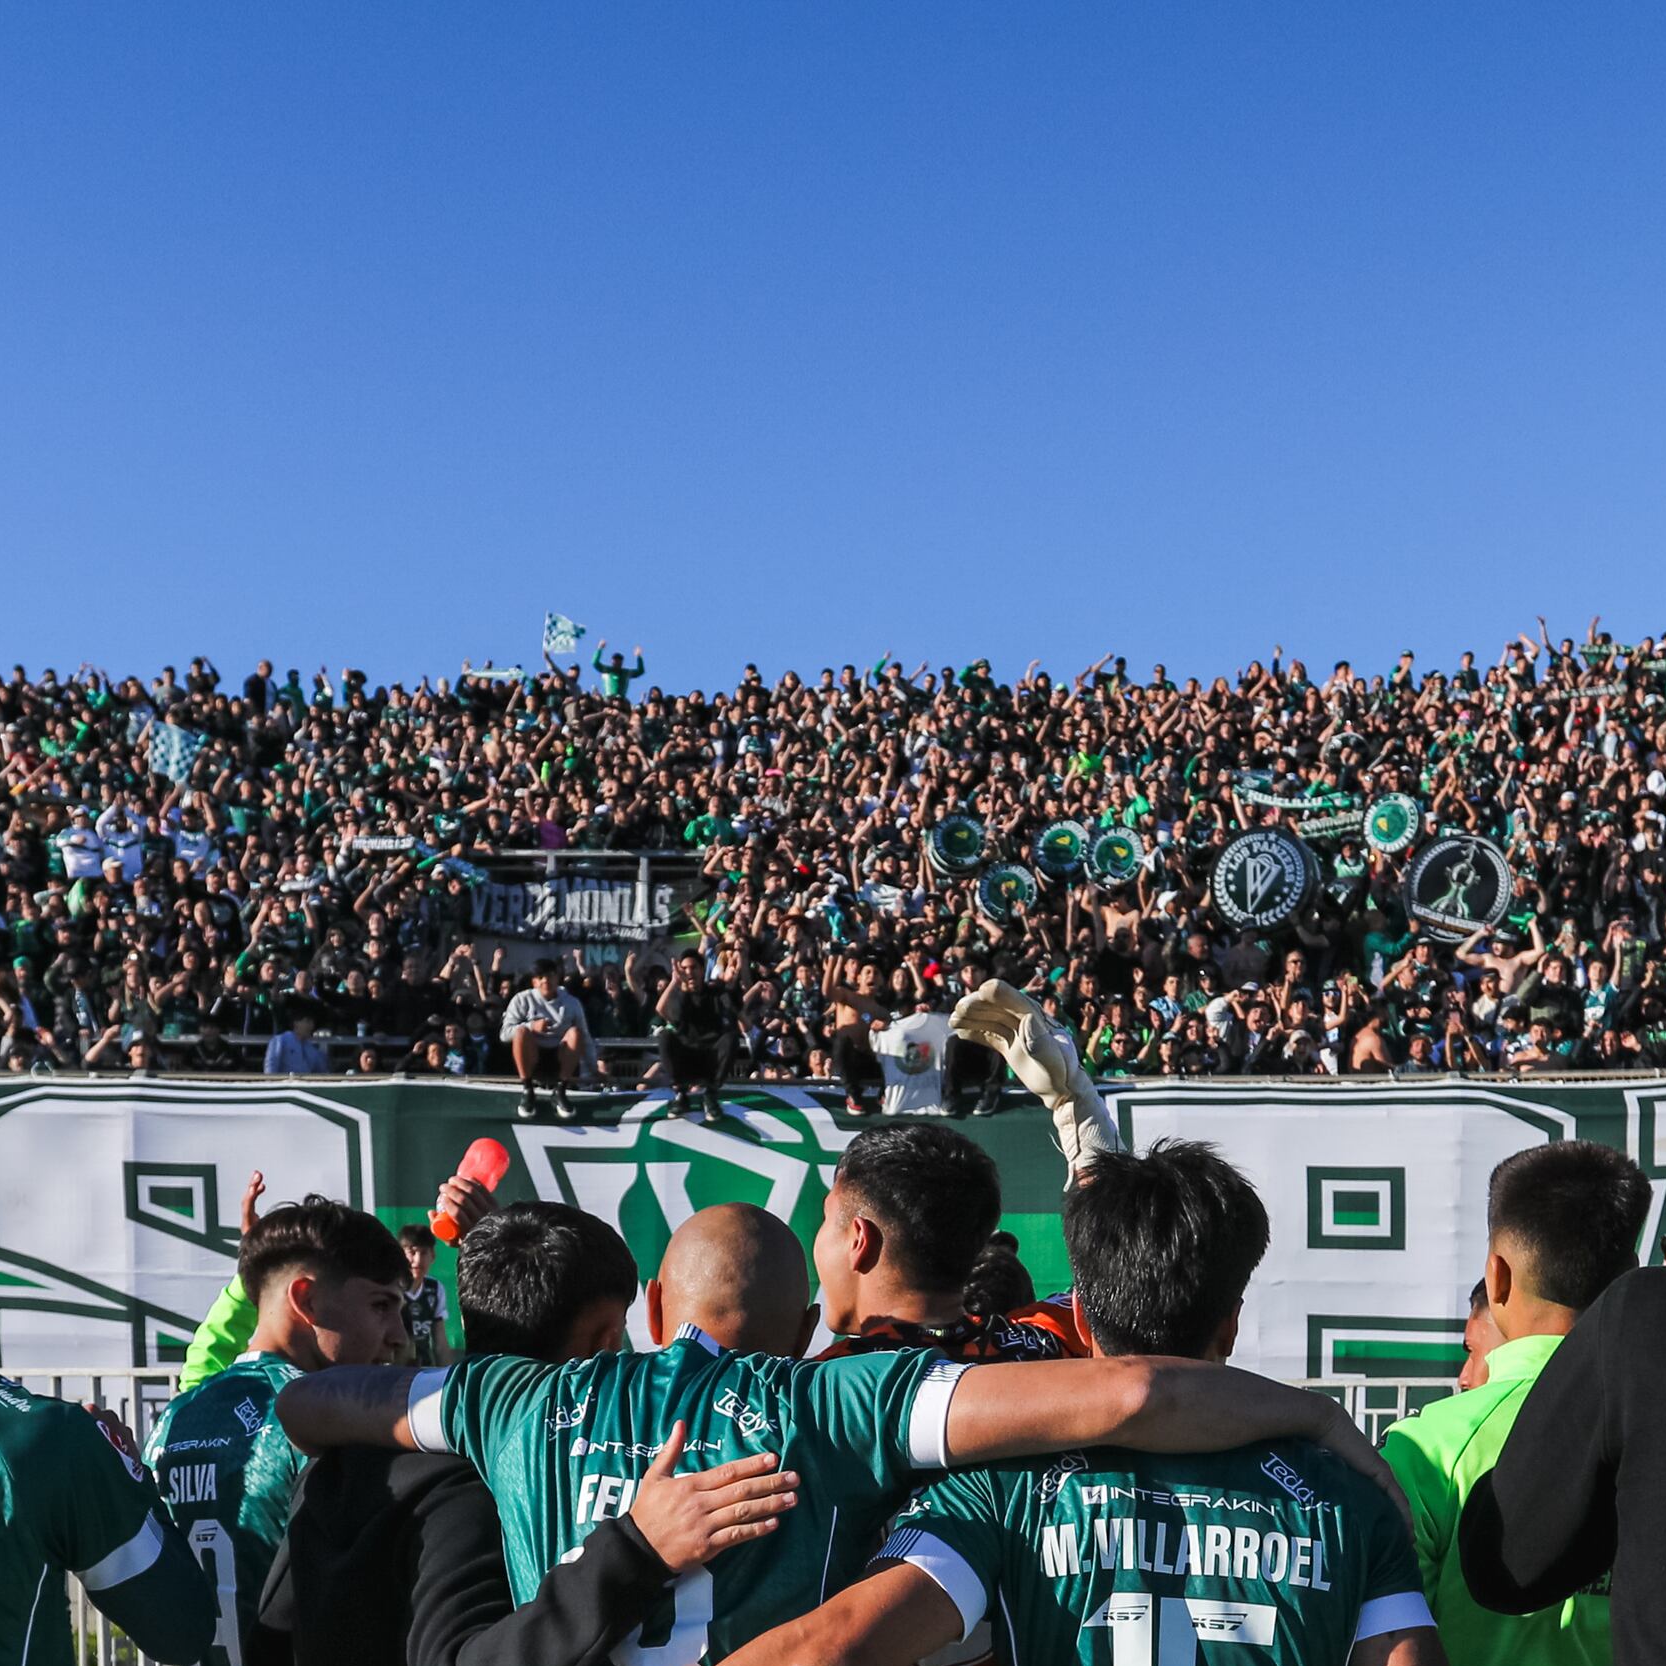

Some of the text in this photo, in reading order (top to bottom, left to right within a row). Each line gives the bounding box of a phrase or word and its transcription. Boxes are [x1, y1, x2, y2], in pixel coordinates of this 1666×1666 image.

[168, 1462, 217, 1505] SILVA
[1110, 1485, 1275, 1516] INTEGRAKIN
[1260, 1452, 1319, 1511] Teddy
